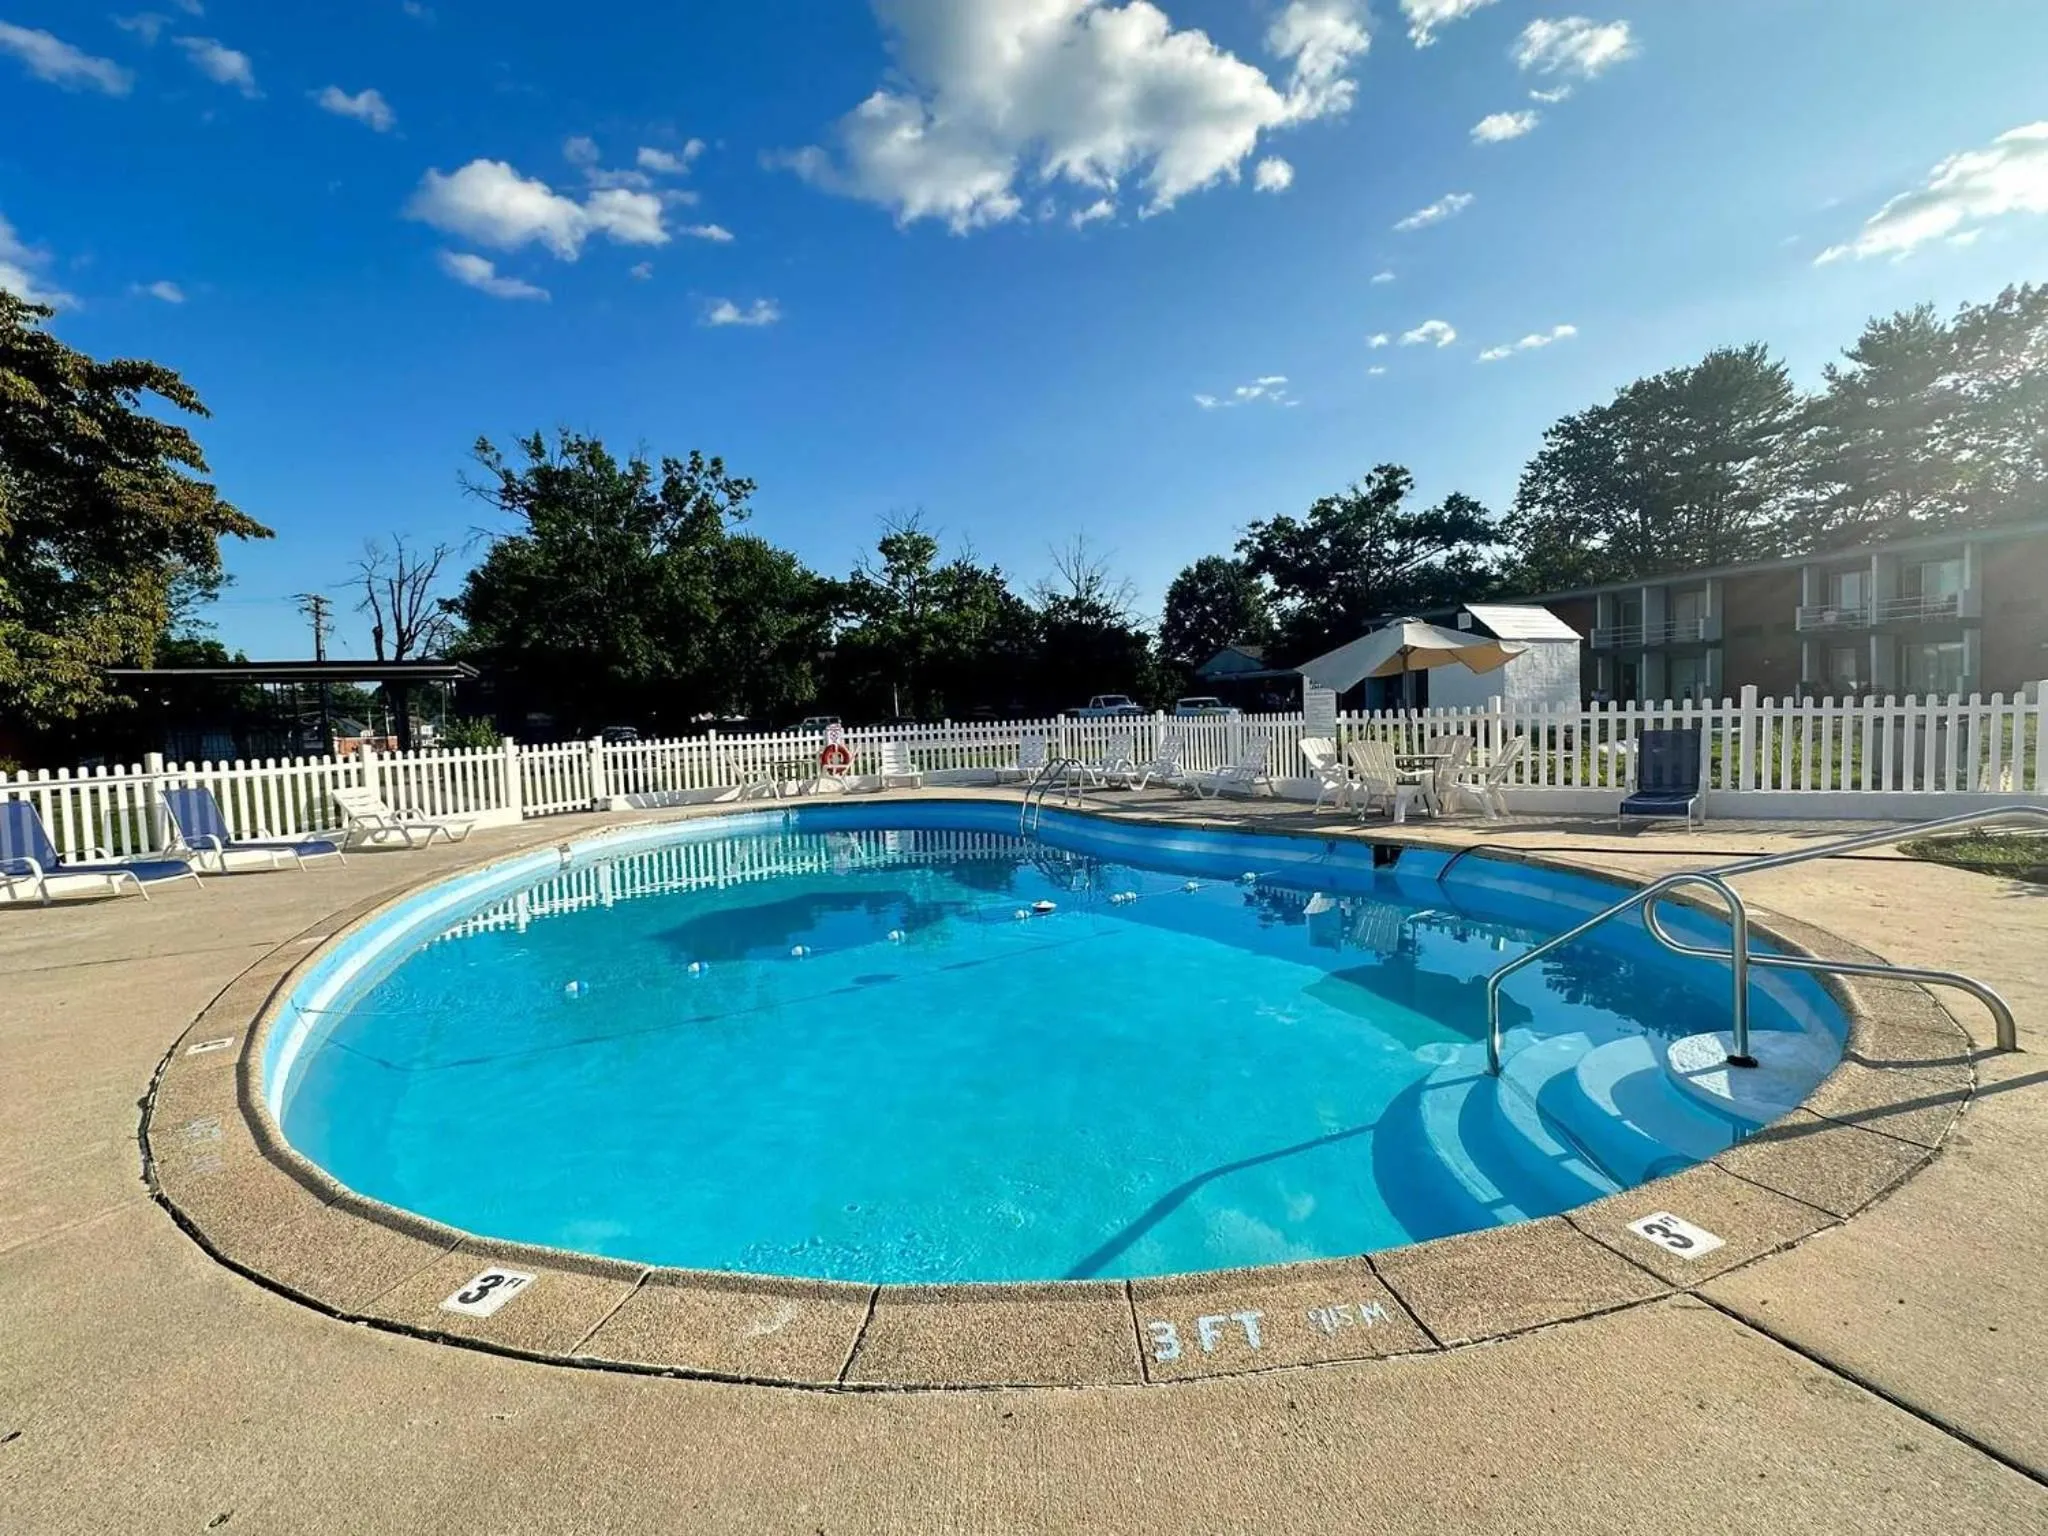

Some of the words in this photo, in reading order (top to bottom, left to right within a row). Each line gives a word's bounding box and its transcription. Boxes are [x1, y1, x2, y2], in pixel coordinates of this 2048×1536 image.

[1643, 1223, 1694, 1249] 3
[458, 1274, 505, 1304] 3
[1149, 1319, 1182, 1361] 3
[1197, 1310, 1263, 1354] FT
